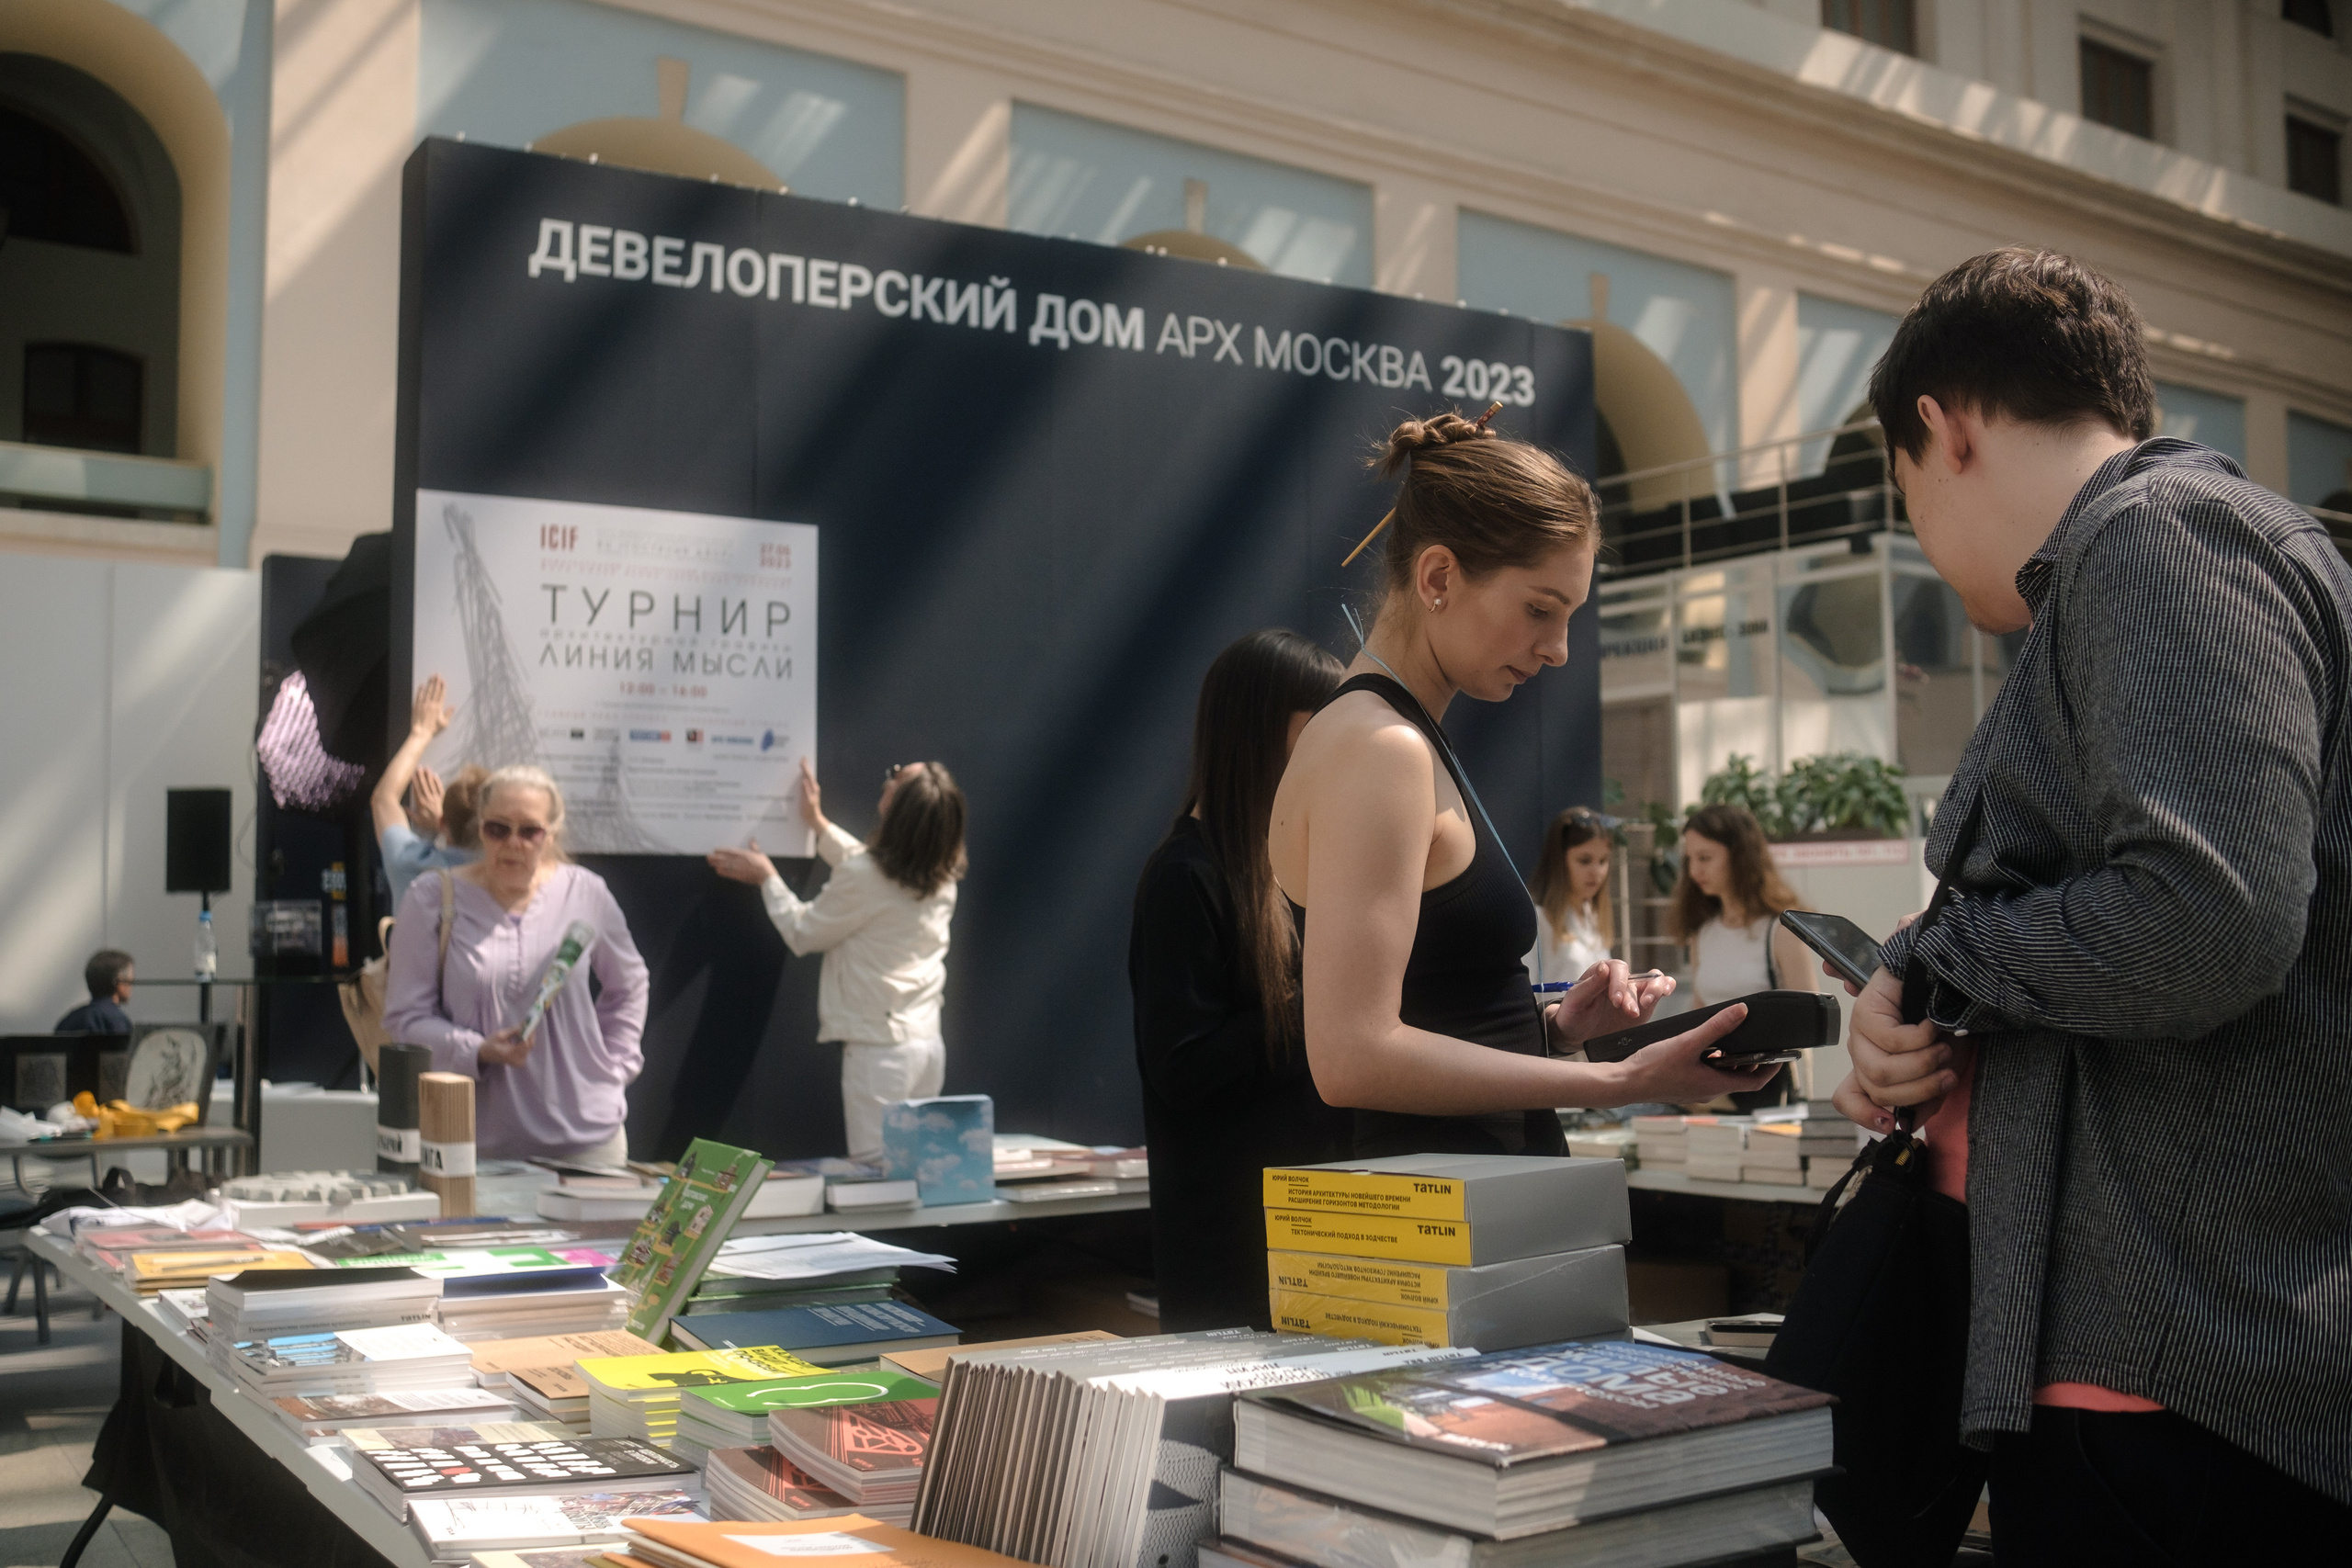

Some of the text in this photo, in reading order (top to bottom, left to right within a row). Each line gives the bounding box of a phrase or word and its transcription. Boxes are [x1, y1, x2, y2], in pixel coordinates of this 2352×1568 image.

[528, 217, 1536, 407] ДЕВЕЛОПЕРСКИЙ ДОМ АРХ МОСКВА 2023
[540, 525, 578, 550] ICIF
[540, 583, 791, 637] ТУРНИР
[538, 643, 792, 679] ЛИНИЯ МЫСЛИ
[1272, 1174, 1287, 1182] ЮРИЙ
[1312, 1190, 1351, 1199] АРХИТЕКТУРЫ
[1351, 1191, 1385, 1201] НОВЕЙШЕГО
[1385, 1194, 1411, 1203] ВРЕМЕНИ
[1288, 1197, 1400, 1211] РАСШИРЕНИЕ ГОРИЗОНТОВ МЕТОДОЛОГИИ
[1291, 1228, 1336, 1238] ТЕКТОНИЧЕСКИЙ
[1336, 1232, 1360, 1241] ПОДХОД
[1365, 1235, 1398, 1243] ЗОДЧЕСТВЕ
[1317, 1261, 1420, 1279] РАСШИРЕНИЕ ГОРИЗОНТОВ МЕТОДОЛОГИИ
[1331, 1270, 1361, 1280] НОВЕЙШЕГО
[1361, 1274, 1396, 1285] АРХИТЕКТУРЫ
[1397, 1279, 1421, 1288] ИСТОРИЯ
[1400, 1293, 1439, 1304] ЮРИЙ ВОЛЧОК
[1357, 1316, 1379, 1327] ПОДХОД
[1378, 1320, 1422, 1332] ТЕКТОНИЧЕСКИЙ
[1547, 1350, 1729, 1396] жилые
[1498, 1357, 1696, 1404] дома
